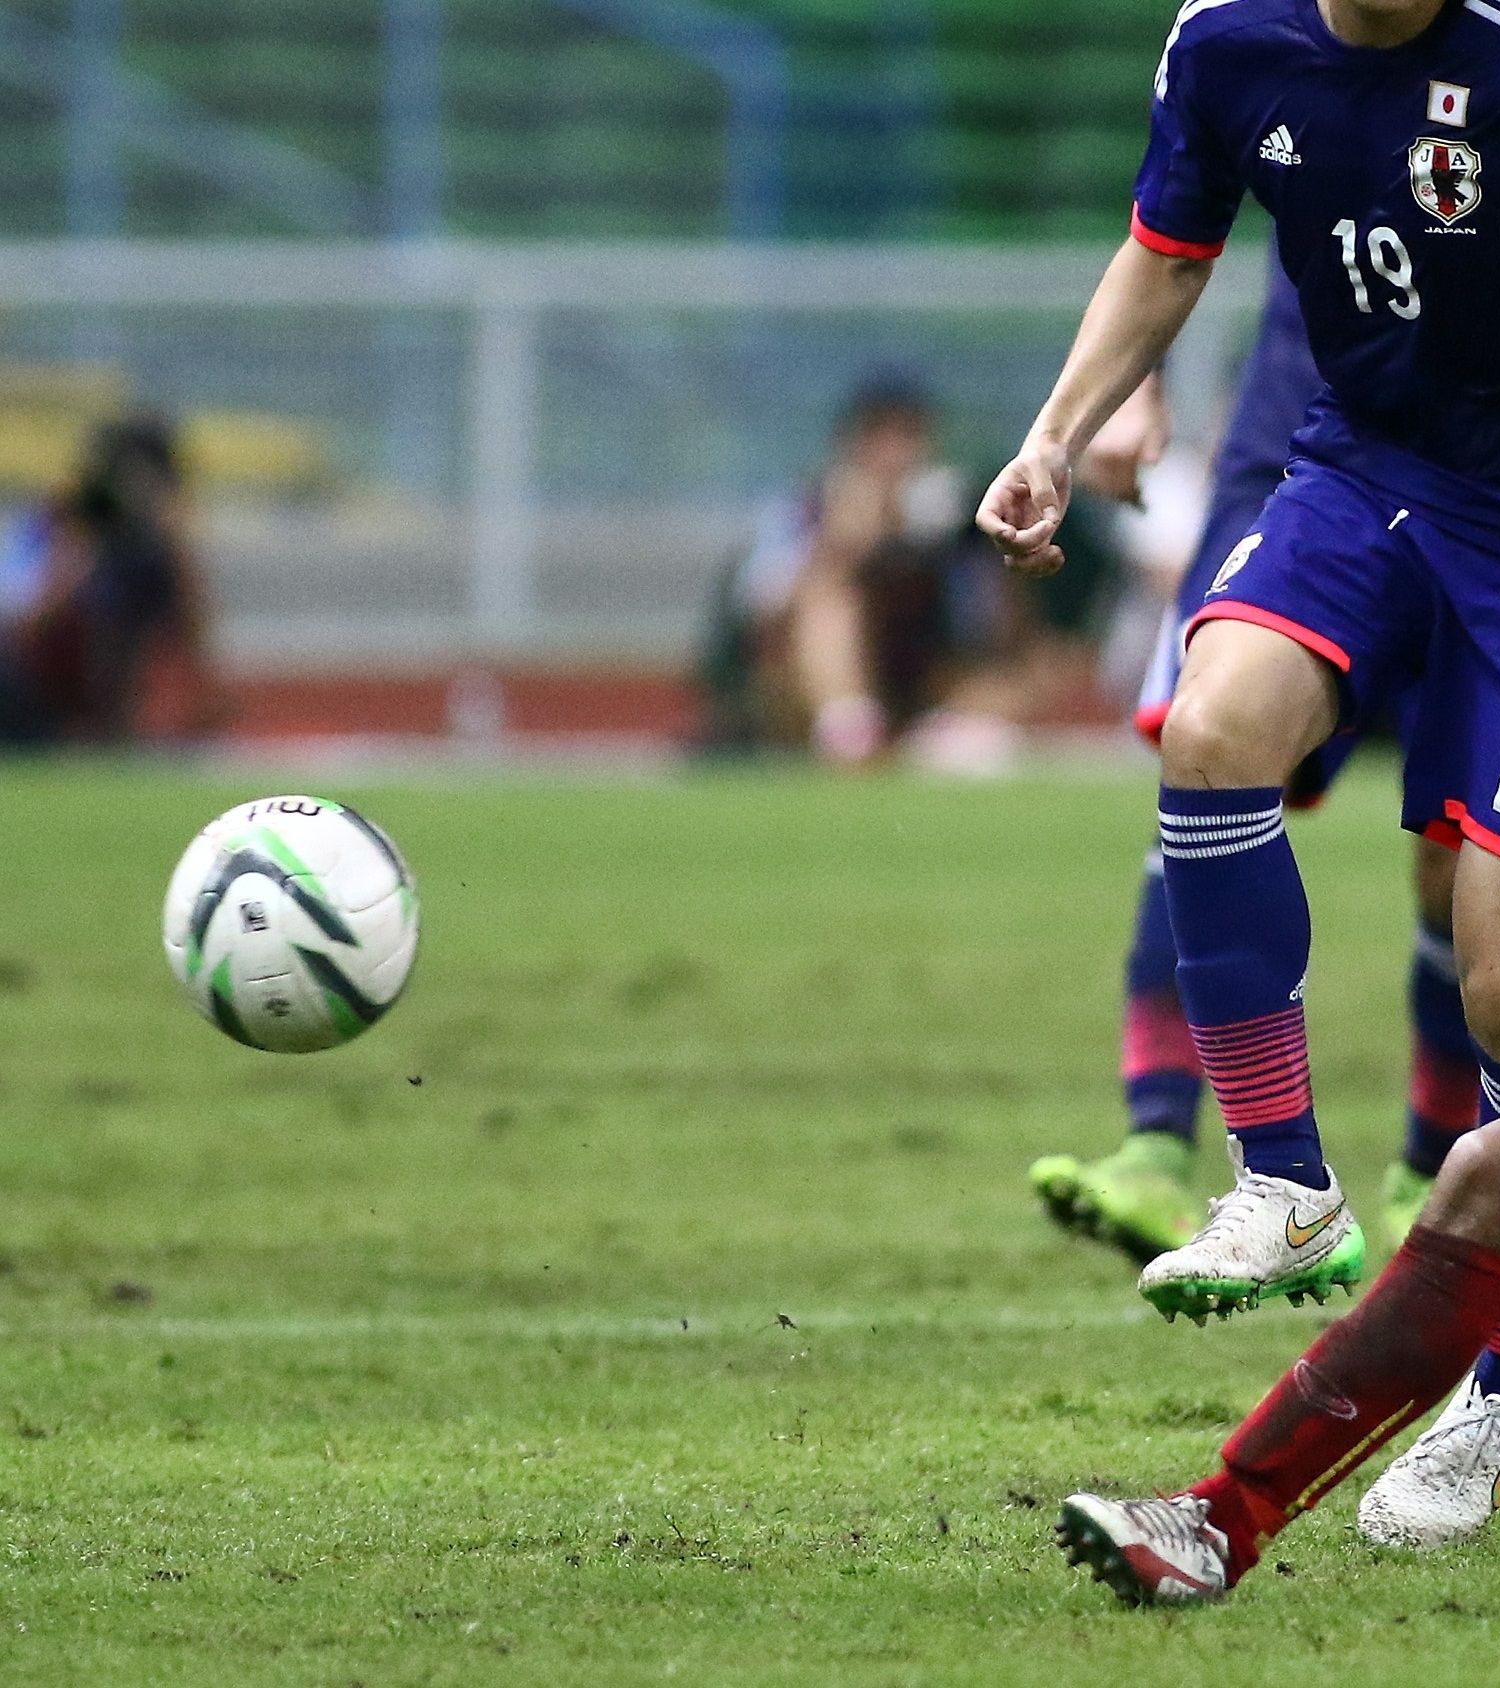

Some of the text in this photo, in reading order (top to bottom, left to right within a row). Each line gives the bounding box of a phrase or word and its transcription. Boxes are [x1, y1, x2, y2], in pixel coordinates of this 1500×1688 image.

[1259, 146, 1302, 165] adidas
[1424, 226, 1477, 235] JAPAN
[1331, 218, 1421, 320] 19
